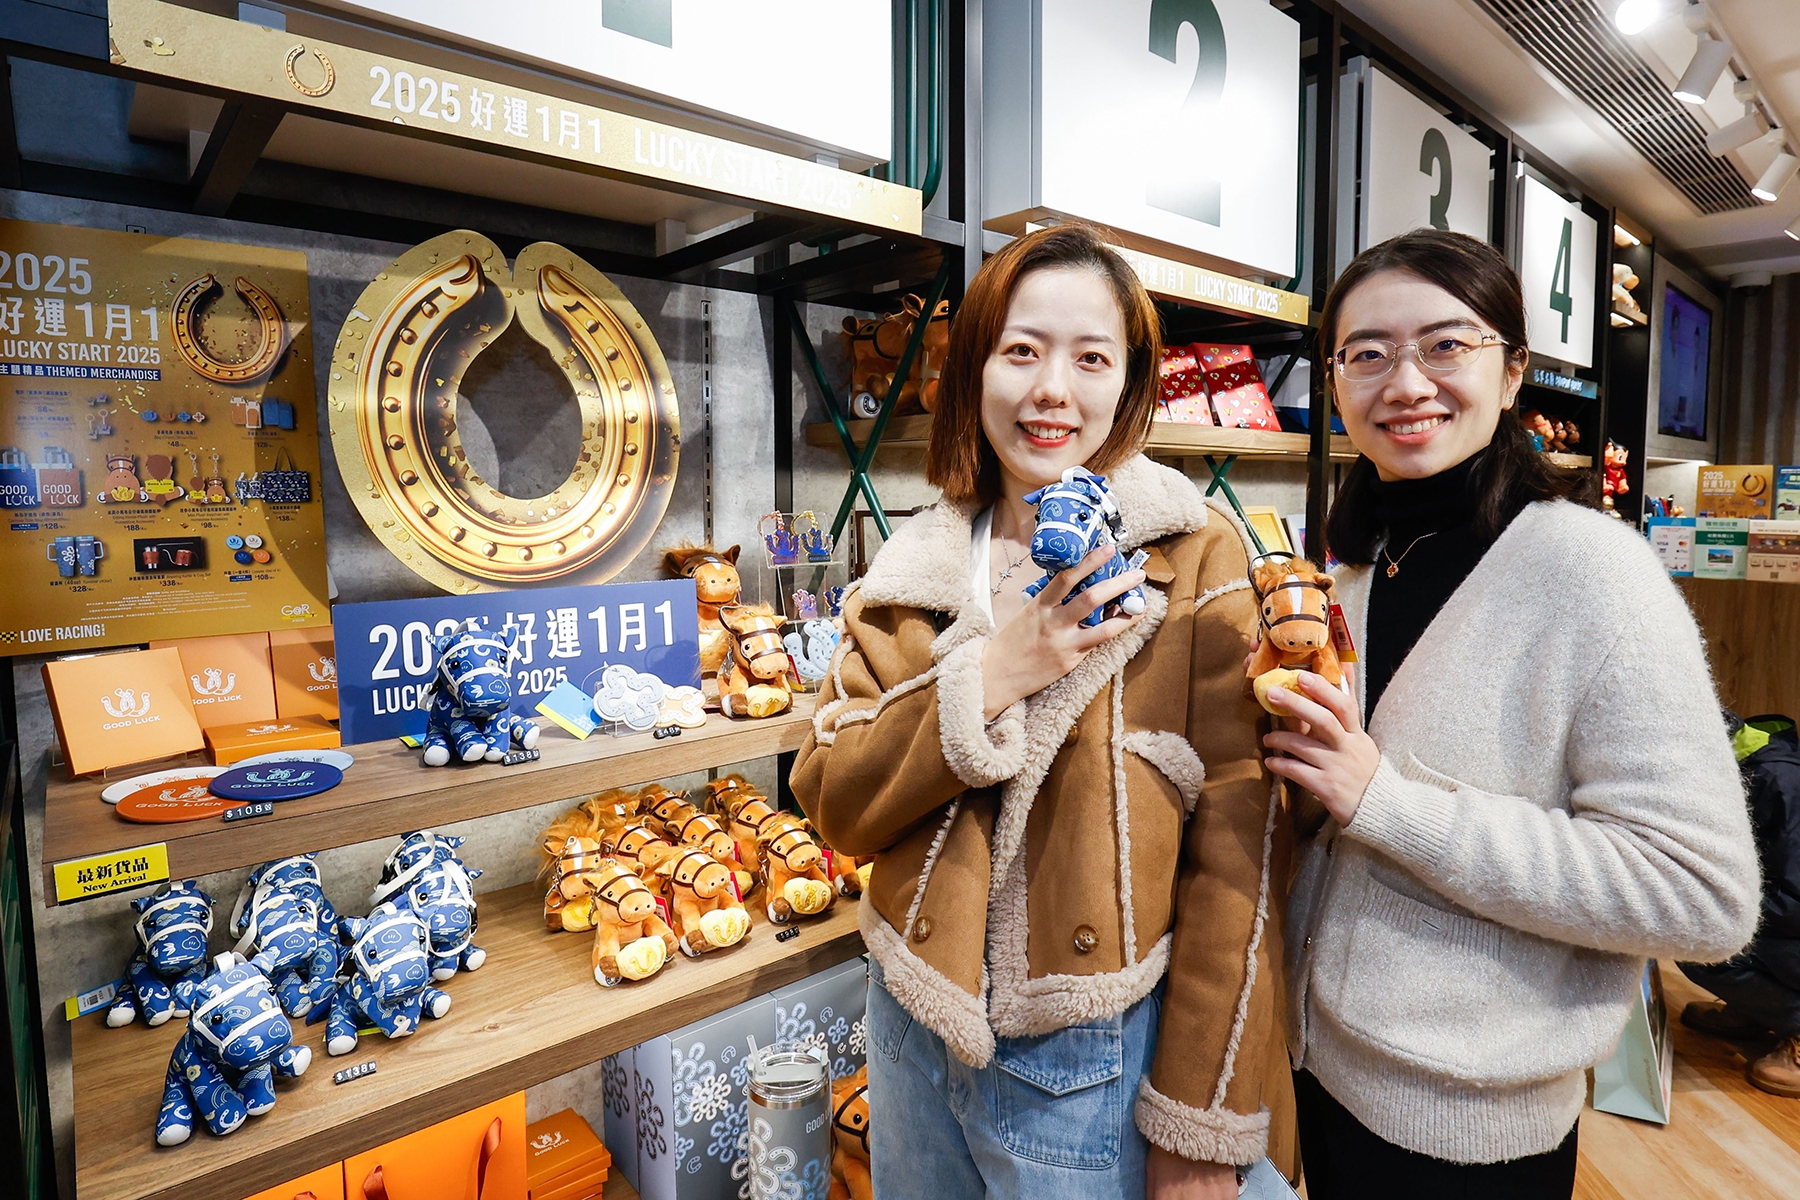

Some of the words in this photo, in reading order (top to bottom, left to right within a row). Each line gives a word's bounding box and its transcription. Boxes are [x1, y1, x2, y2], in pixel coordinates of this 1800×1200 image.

[1146, 0, 1227, 228] 2
[633, 127, 718, 180] LUCKY
[721, 150, 792, 198] START
[798, 172, 852, 213] 2025
[0, 250, 92, 295] 2025
[1549, 217, 1572, 344] 4
[1194, 273, 1226, 303] LUCKY
[1226, 281, 1255, 307] START
[1255, 290, 1279, 314] 2025
[0, 294, 159, 341] 好運1月1
[0, 338, 53, 360] UCKY
[58, 342, 111, 362] START
[116, 345, 161, 365] 2025
[45, 365, 87, 378] THEMED
[90, 368, 159, 381] MERCHANDISE
[43, 484, 72, 495] GOOD
[50, 494, 80, 505] LUCK
[20, 628, 53, 643] LOVE
[55, 624, 101, 640] RACING
[306, 684, 330, 692] GOOD
[517, 666, 568, 696] 2025
[217, 694, 242, 703] LUCK
[102, 720, 132, 730] GOOD
[134, 715, 161, 725] LUCK
[83, 883, 107, 893] New
[110, 873, 146, 887] Arrival
[806, 1113, 824, 1134] GOOD
